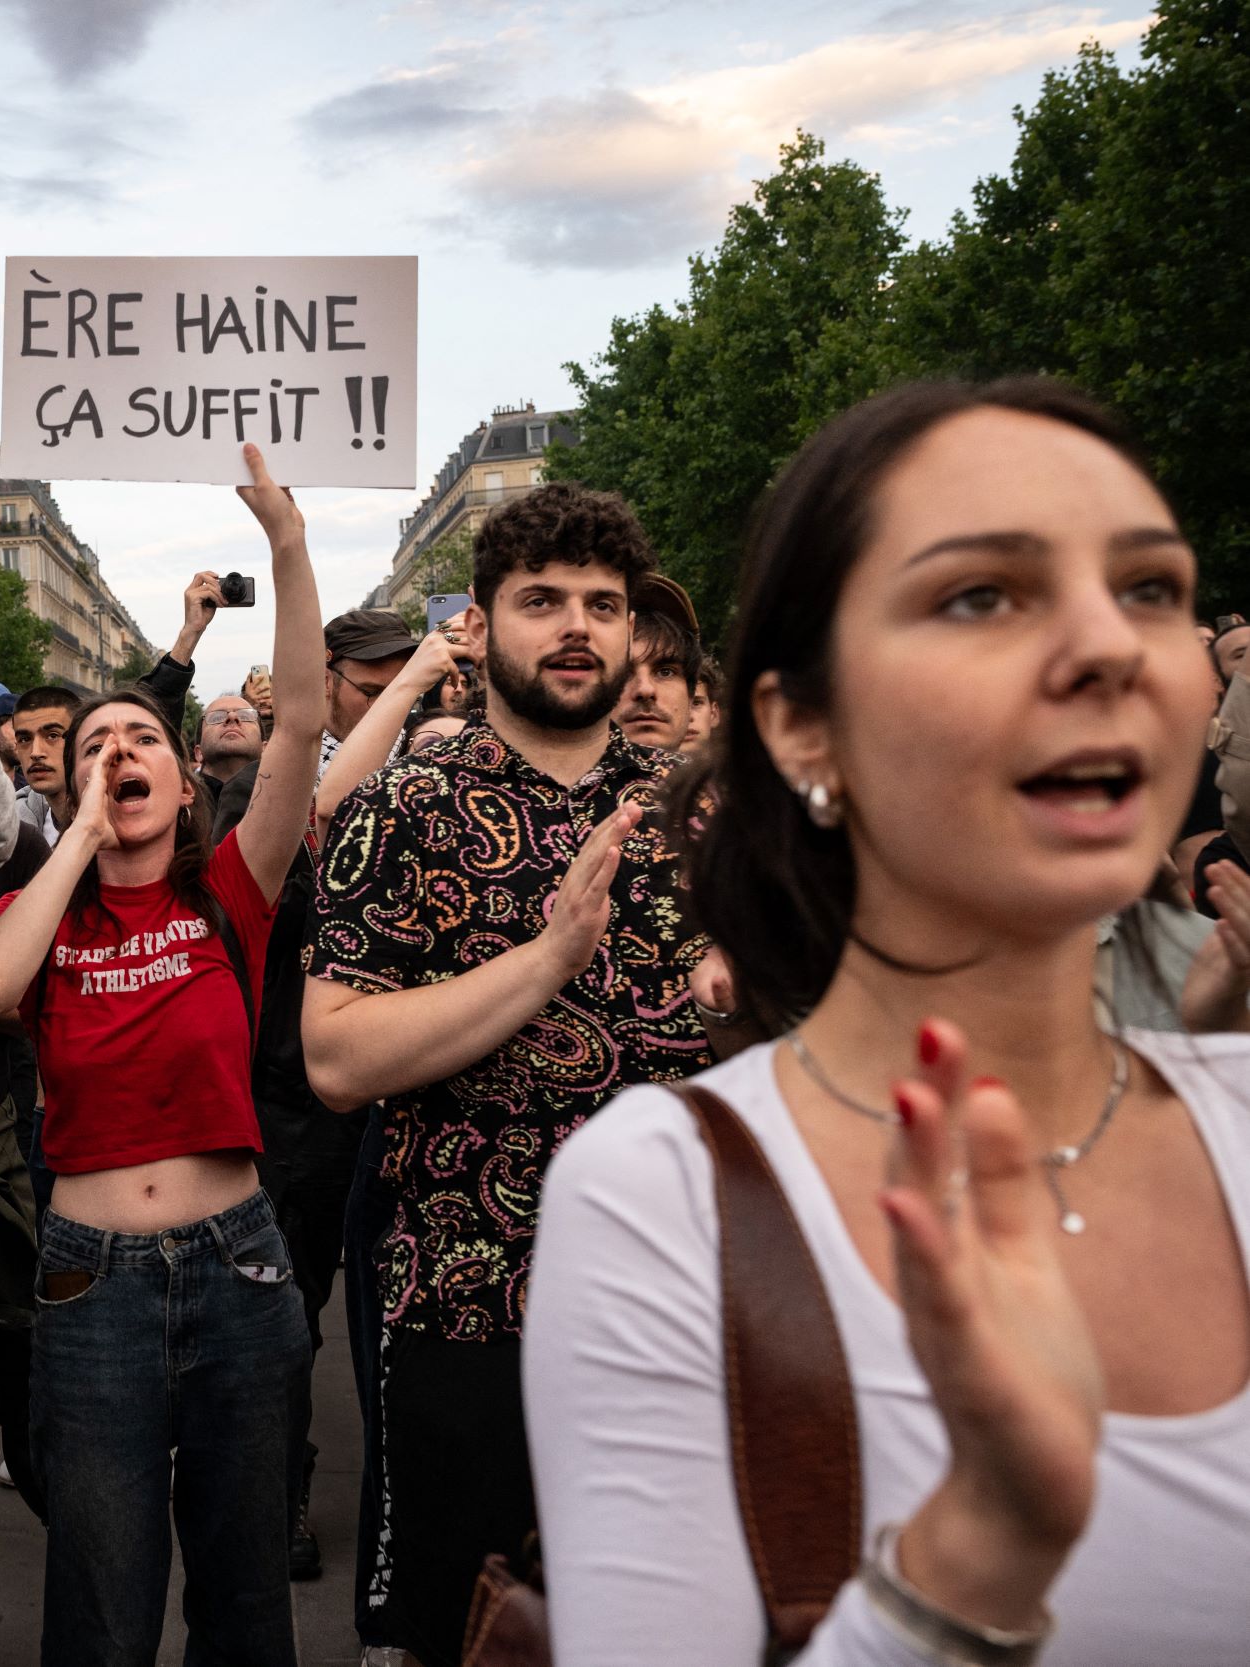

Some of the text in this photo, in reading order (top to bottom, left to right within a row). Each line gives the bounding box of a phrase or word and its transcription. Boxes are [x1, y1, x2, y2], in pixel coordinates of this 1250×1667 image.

[20, 269, 143, 358] ÈRE
[35, 384, 104, 448] ÇA
[344, 375, 390, 451] !!
[55, 945, 117, 968] STADE
[119, 934, 141, 958] DE
[80, 952, 193, 996] ATHLETISME
